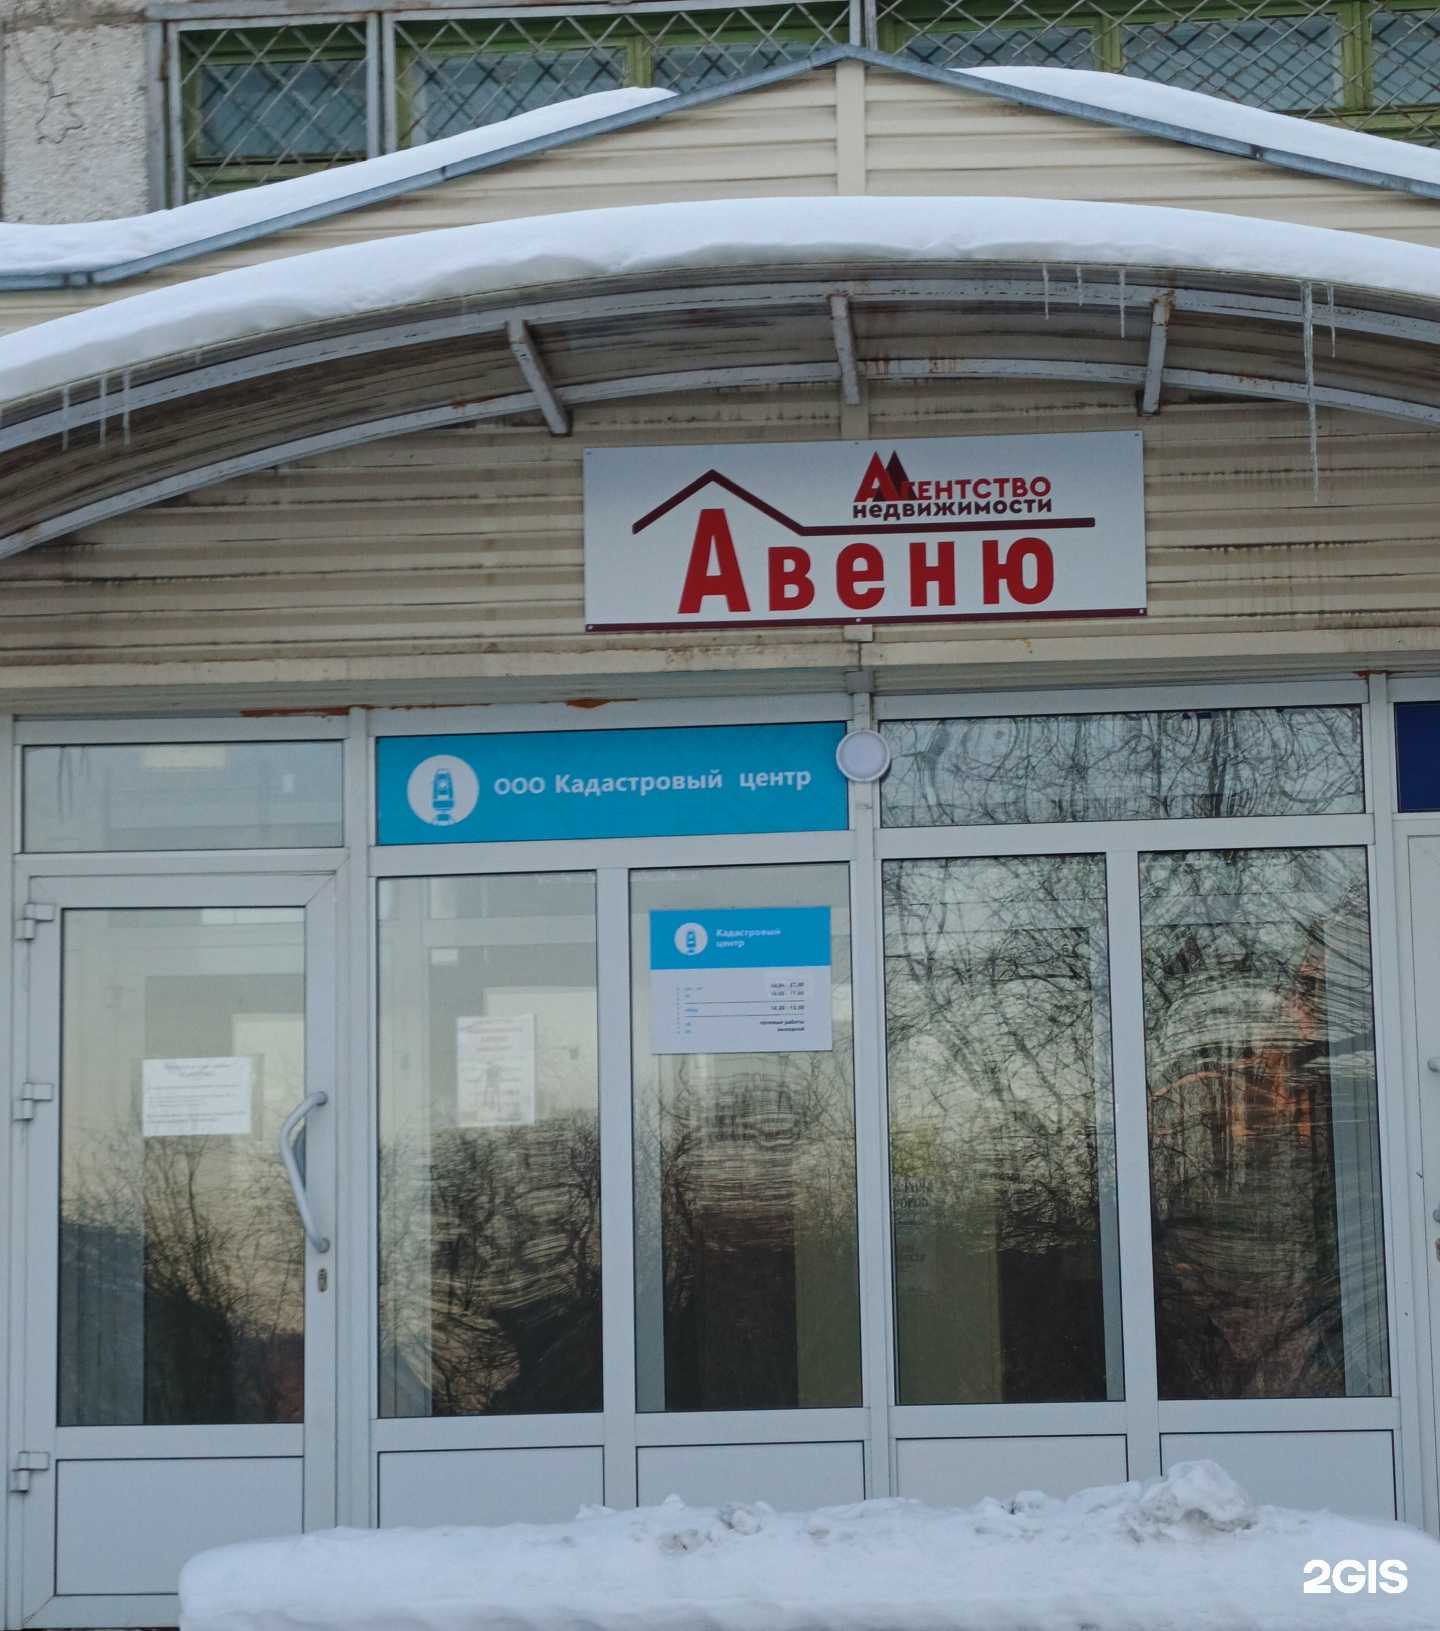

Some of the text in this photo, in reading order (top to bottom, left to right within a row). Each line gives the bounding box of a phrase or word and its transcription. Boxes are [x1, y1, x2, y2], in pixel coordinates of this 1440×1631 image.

[853, 499, 1052, 521] недвижимости
[678, 508, 1054, 613] Авеню
[494, 769, 811, 796] ООО Кадастровый центр
